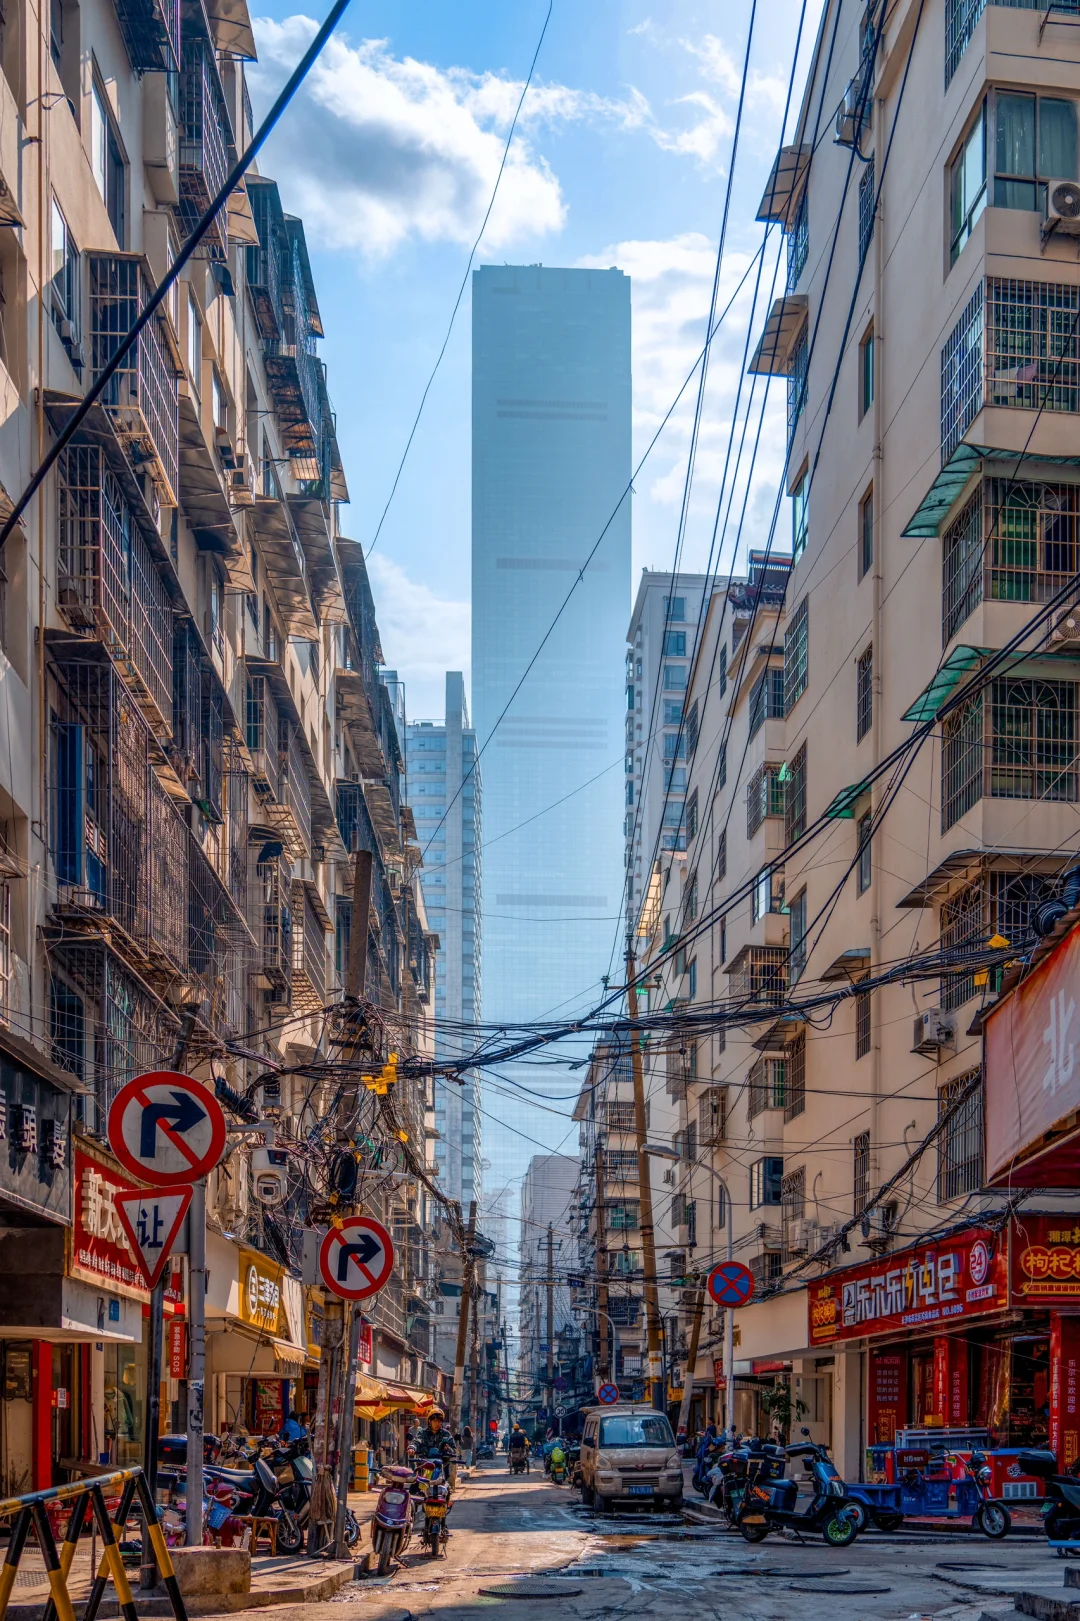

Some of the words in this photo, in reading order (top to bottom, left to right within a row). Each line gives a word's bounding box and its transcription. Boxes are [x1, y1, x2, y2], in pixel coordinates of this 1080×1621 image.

[1043, 988, 1075, 1097] 北
[136, 1204, 164, 1249] 让
[970, 1254, 982, 1271] 24
[172, 1355, 180, 1373] SOS
[1067, 1359, 1076, 1413] 乐尔乐欢迎您
[556, 1407, 565, 1415] 30
[952, 1371, 960, 1418] 乐尔乐欢迎您
